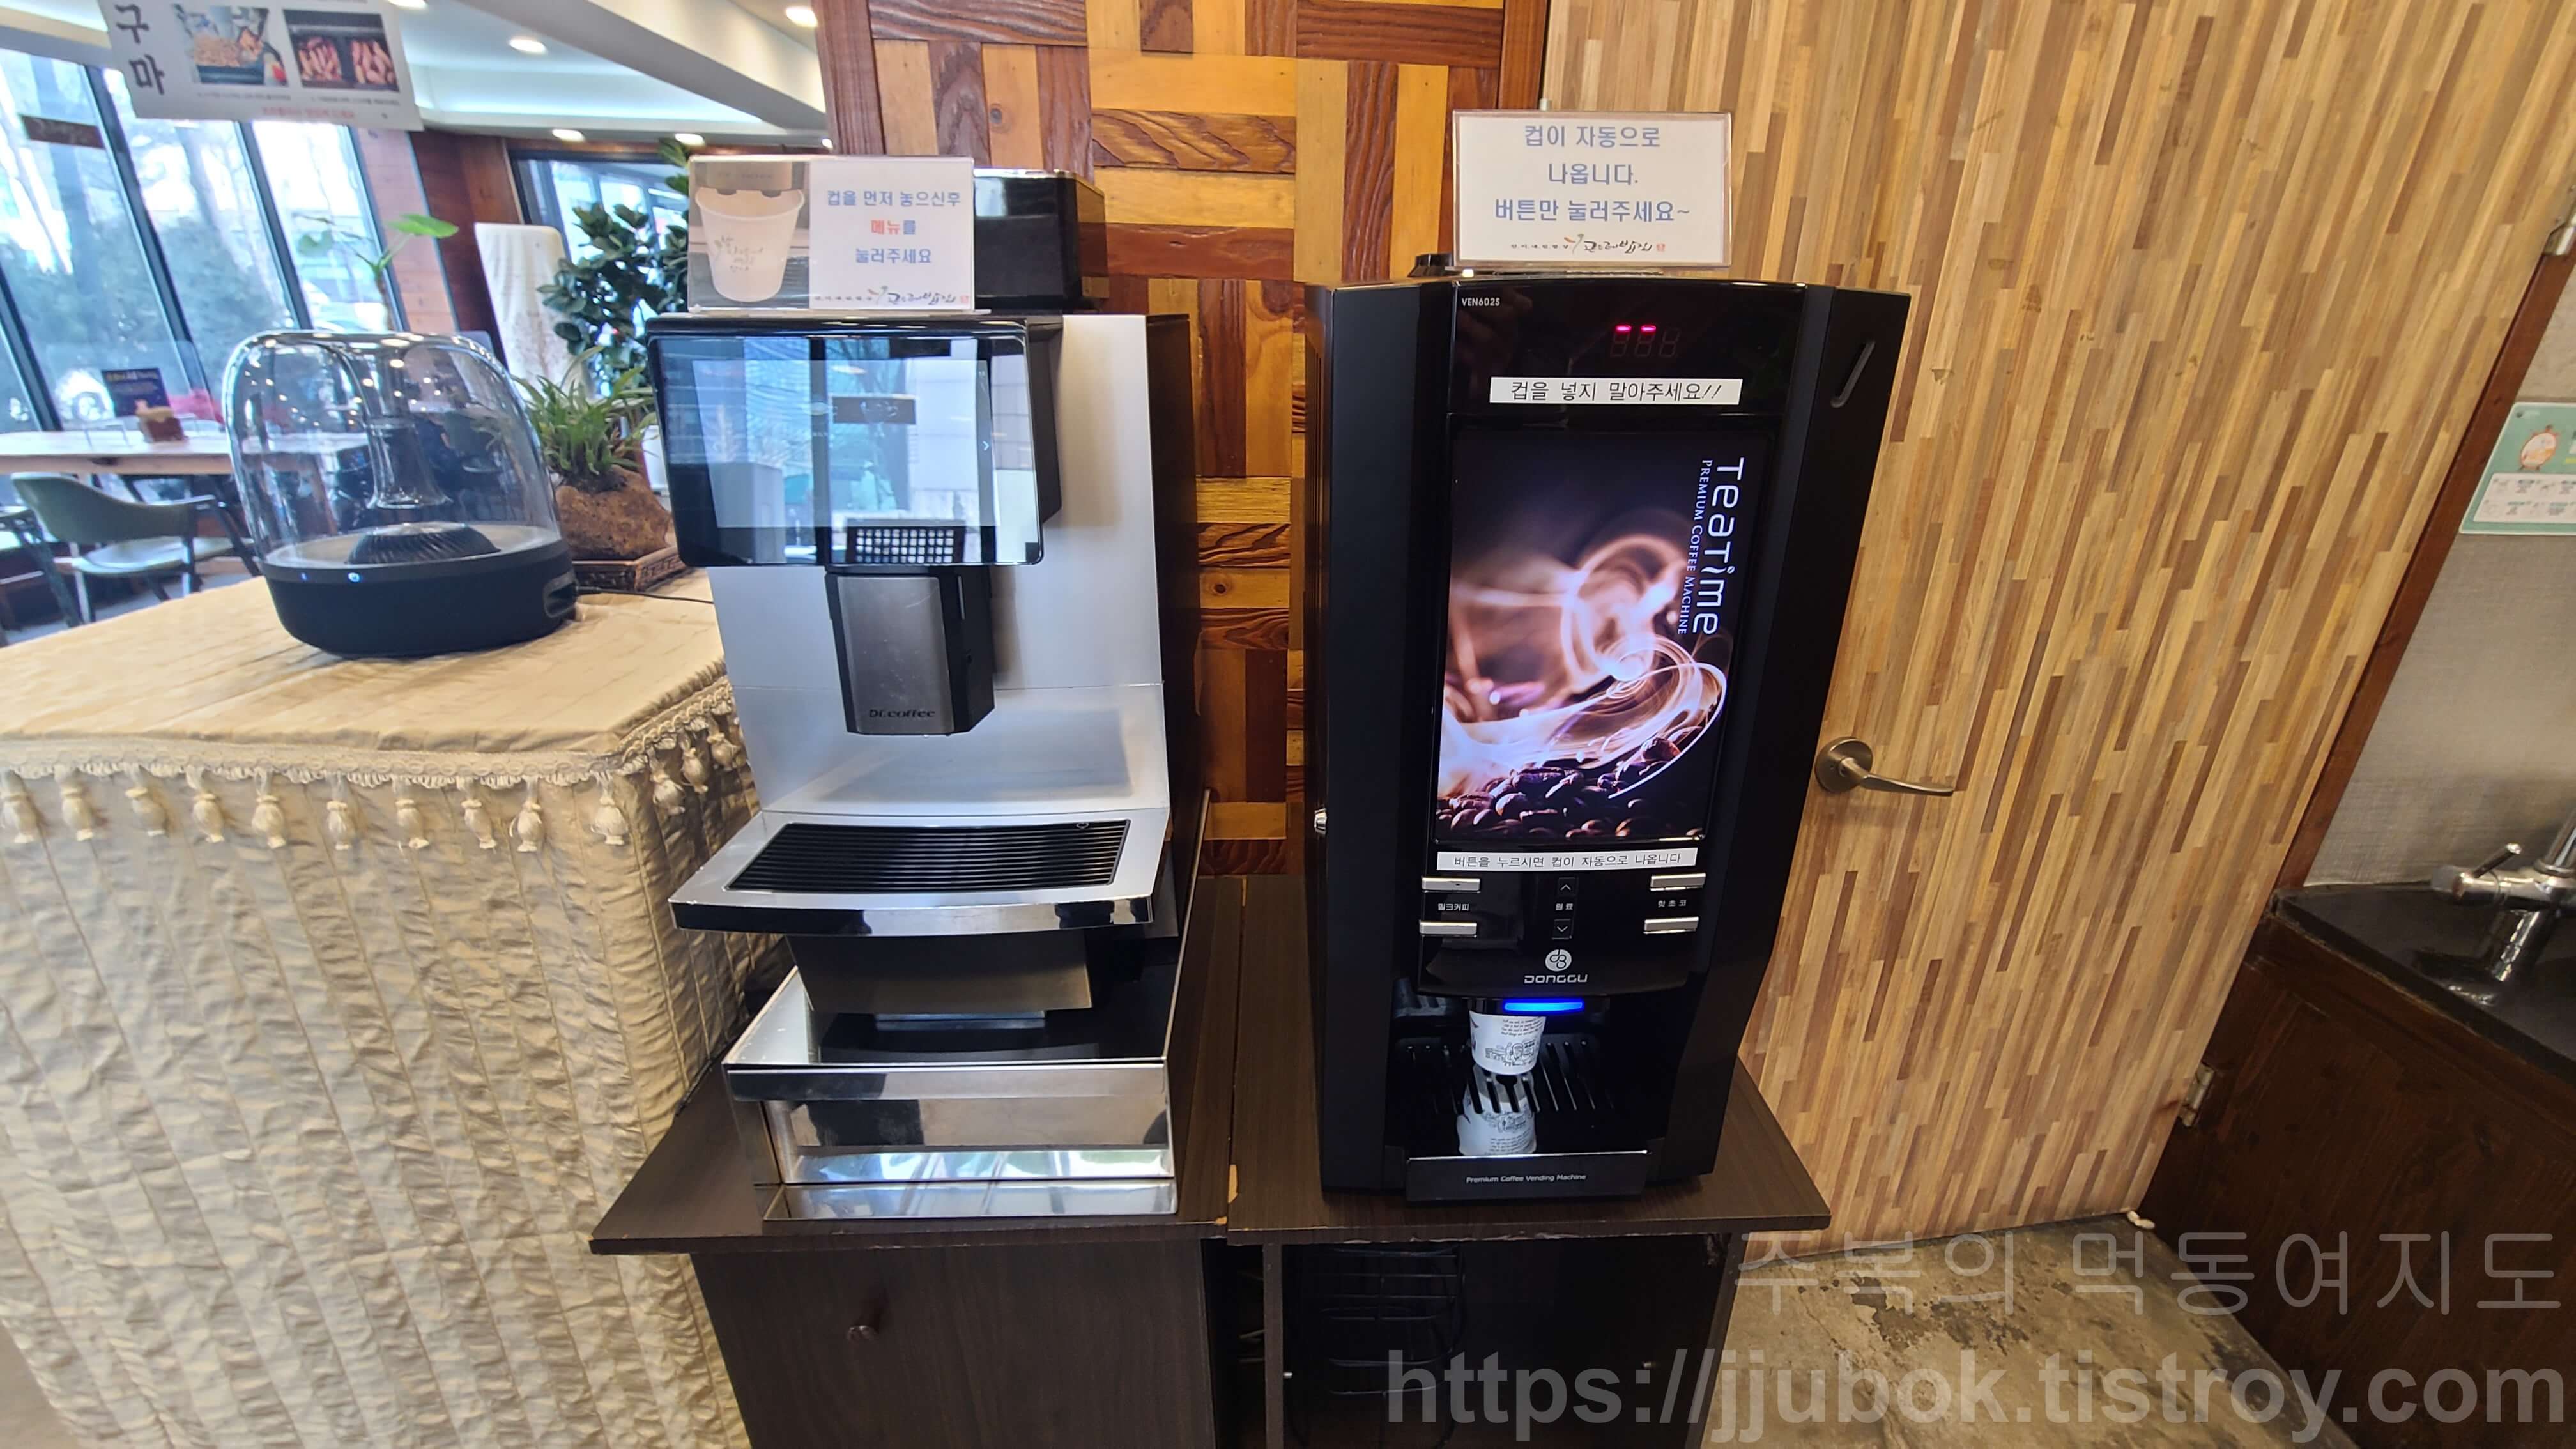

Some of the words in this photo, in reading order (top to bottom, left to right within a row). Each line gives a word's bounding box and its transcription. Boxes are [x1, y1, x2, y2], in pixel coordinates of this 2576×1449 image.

[1524, 125, 1565, 147] 컵이
[1576, 125, 1660, 148] 자동으로
[1548, 163, 1639, 185] 나옵니다.
[827, 190, 856, 206] 컵을
[864, 191, 893, 206] 먼저
[900, 191, 961, 207] 놓으신후
[1495, 199, 1559, 222] 버튼만
[1568, 200, 1690, 222] 눌러주세요~
[871, 219, 916, 235] 메뉴를
[856, 248, 931, 264] 눌러주세요
[1511, 381, 1549, 401] 컵을
[1561, 381, 1597, 401] 넣지
[1609, 382, 1722, 401] 말아주세요!!
[1694, 459, 1713, 521] PREMIUM
[1686, 525, 1703, 571] COFFEE
[1678, 576, 1694, 634] MACHINE
[1454, 856, 1491, 868] 버튼을
[1497, 856, 1544, 868] 누르시면
[1552, 856, 1574, 868] 컵이
[1581, 855, 1629, 867] 자동으로
[1635, 853, 1681, 865] 나옵니다
[1438, 903, 1469, 911] 밀크커피
